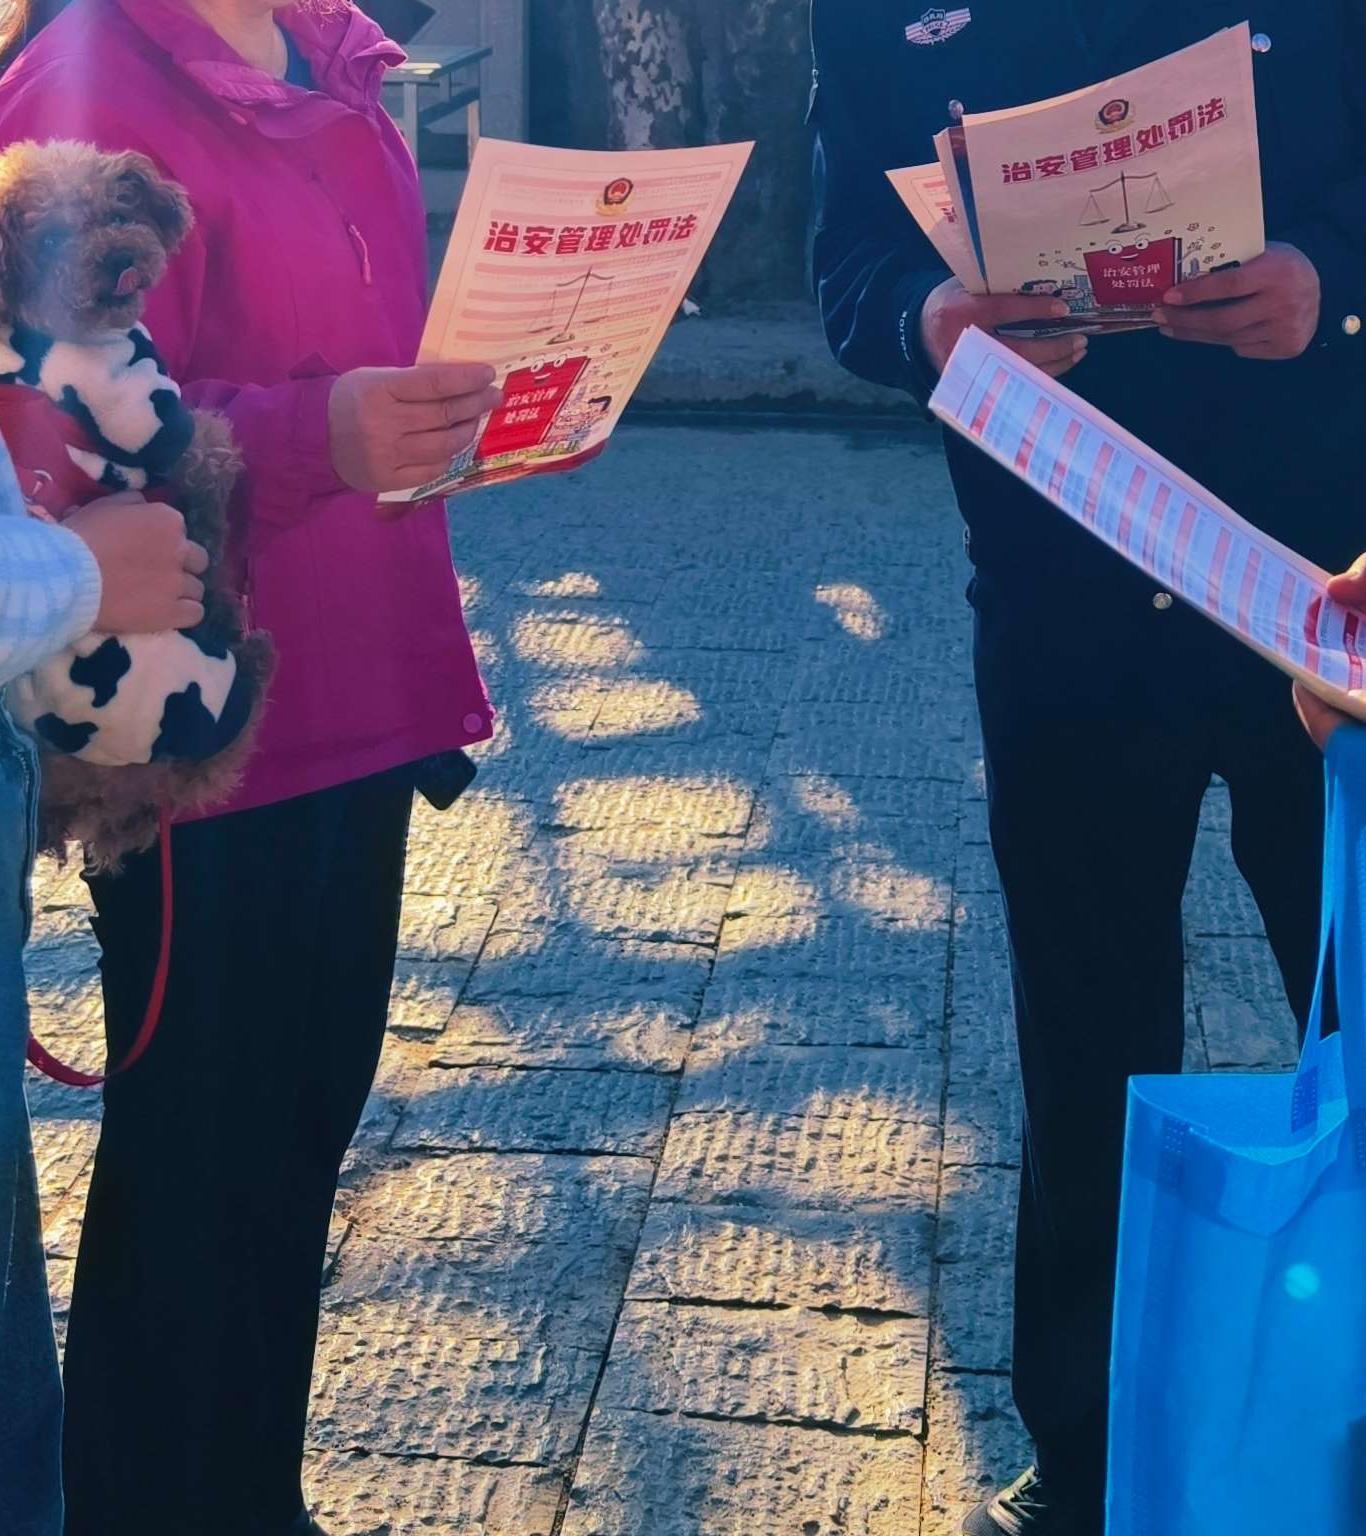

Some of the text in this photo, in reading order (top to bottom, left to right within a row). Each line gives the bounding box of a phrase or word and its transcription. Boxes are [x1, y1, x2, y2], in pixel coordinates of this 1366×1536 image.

[1001, 97, 1227, 184] 治安管理处罚法
[483, 214, 698, 255] 治安管理处罚法
[1103, 263, 1161, 278] 治安管理
